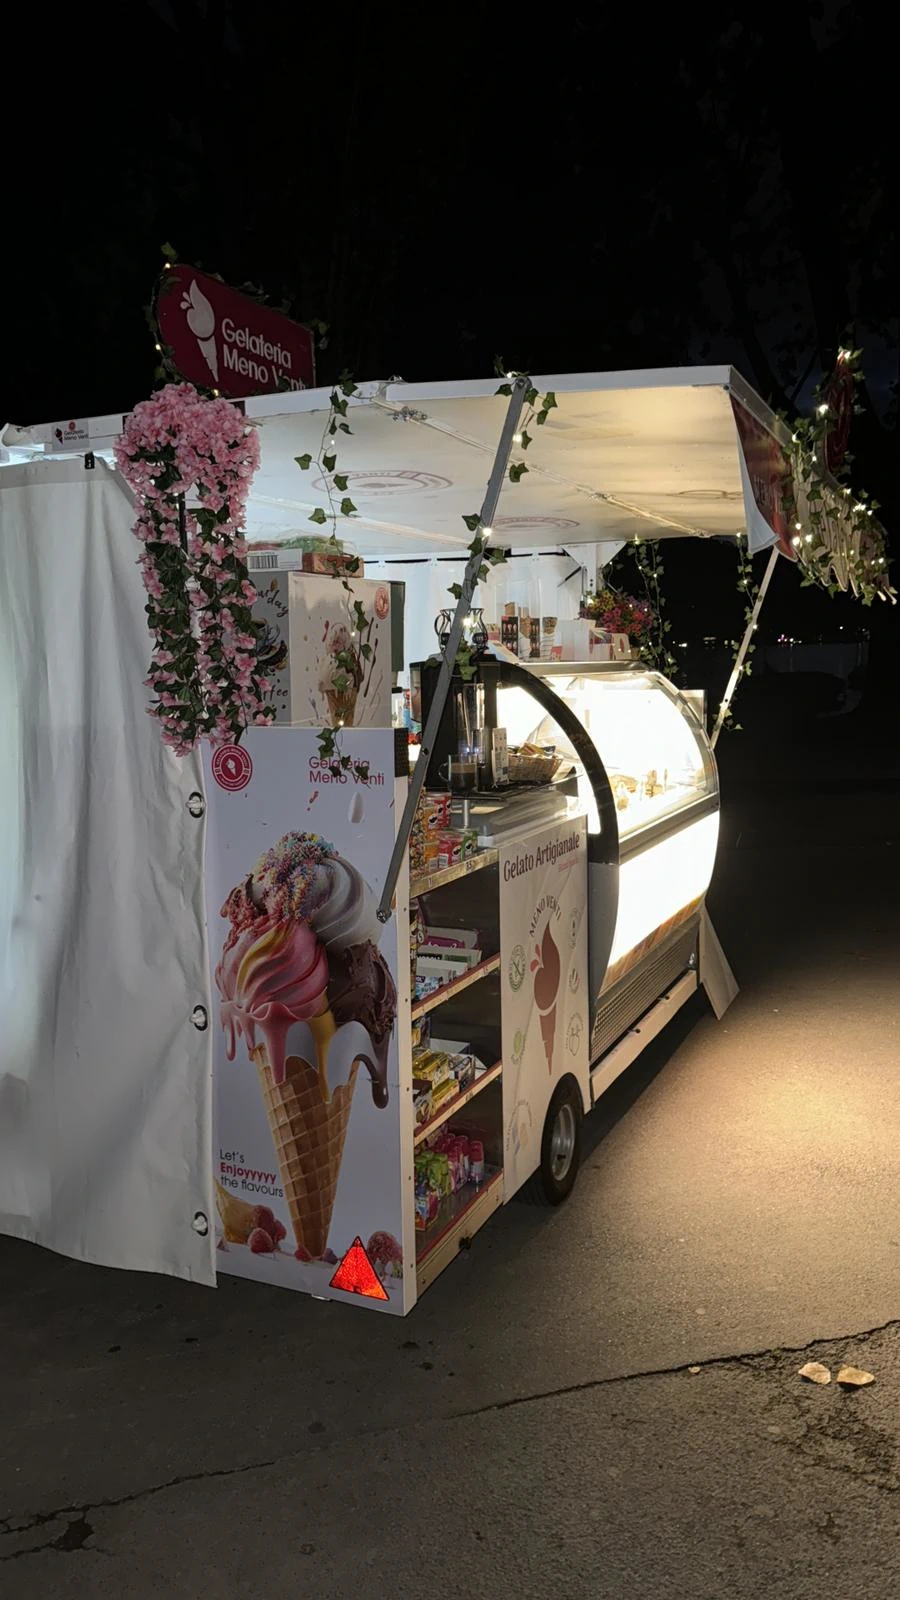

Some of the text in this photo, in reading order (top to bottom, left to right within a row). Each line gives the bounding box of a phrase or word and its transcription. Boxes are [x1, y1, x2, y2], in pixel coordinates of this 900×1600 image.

[222, 318, 292, 368] Gelateria
[223, 343, 269, 384] Meno
[267, 589, 289, 618] day
[309, 756, 370, 770] Gelaeria
[503, 853, 534, 882] Gelato
[535, 831, 580, 868] Artigianale
[529, 897, 546, 938] MENO
[546, 895, 562, 921] VENTI
[220, 1148, 245, 1164] Let's
[220, 1162, 277, 1185] Enjoyyyyy
[220, 1175, 284, 1198] the flavours
